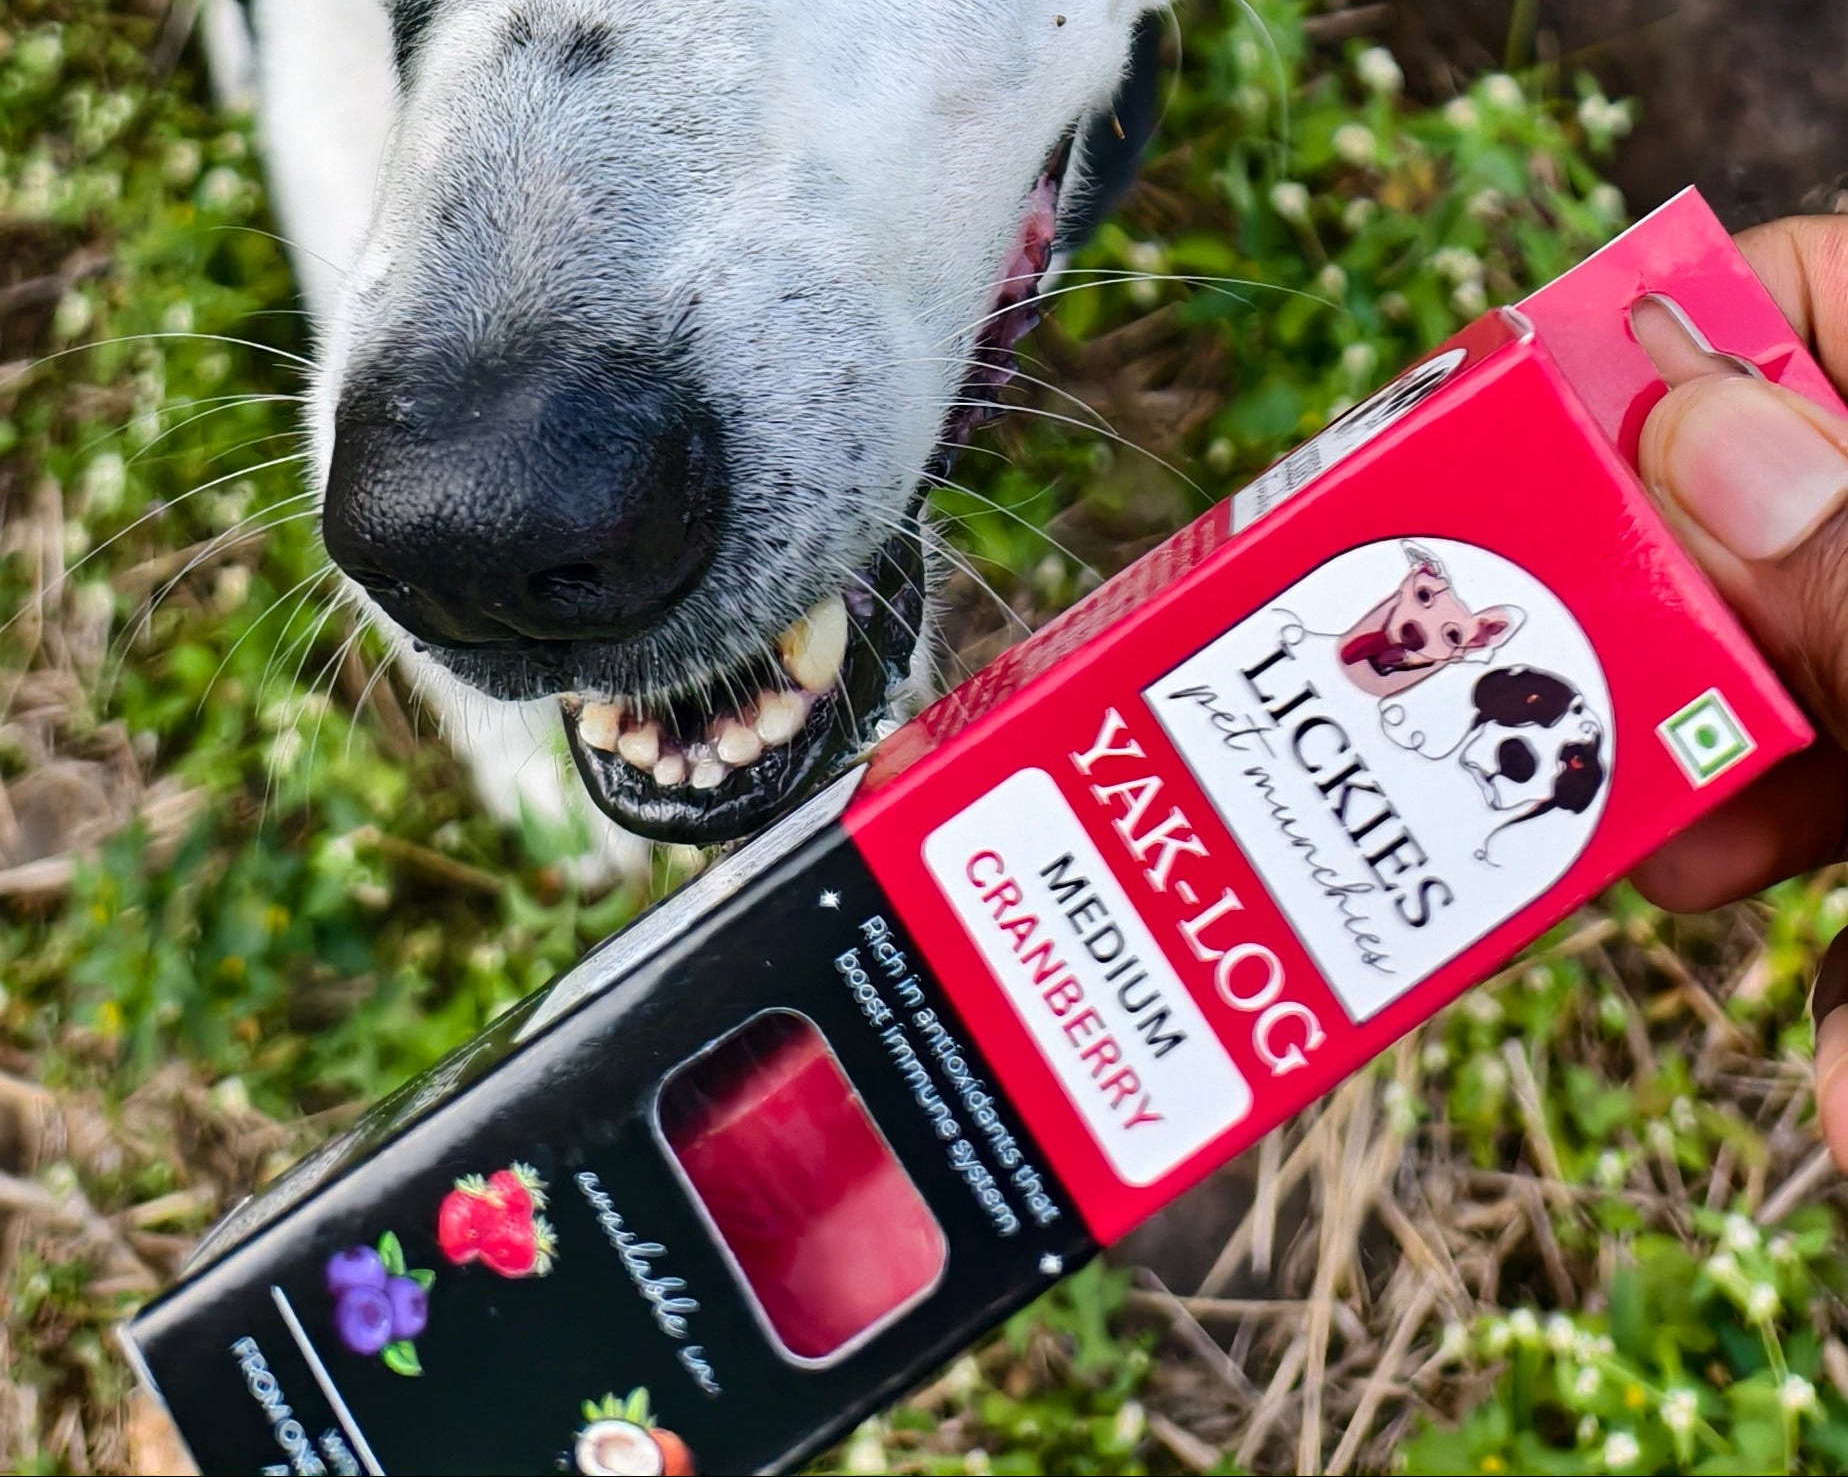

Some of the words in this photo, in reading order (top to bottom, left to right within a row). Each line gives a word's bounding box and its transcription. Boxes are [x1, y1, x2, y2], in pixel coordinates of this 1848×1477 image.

[1068, 707, 1328, 1078] YAK-LOG
[1168, 684, 1278, 760] pet
[1243, 765, 1397, 974] munchies
[1240, 646, 1453, 928] LICKIES
[834, 947, 894, 1027] boost
[879, 1023, 962, 1141] immune
[947, 1139, 1021, 1237] system
[858, 915, 907, 978] Rich
[893, 974, 925, 1007] in
[912, 1008, 1024, 1169] antioxidants
[1011, 1164, 1062, 1226] that
[966, 849, 1164, 1131] CRANBERRY
[1040, 851, 1189, 1059] MEDIUM
[228, 1336, 293, 1423] FROM
[573, 1171, 700, 1339] available
[675, 1345, 722, 1398] in
